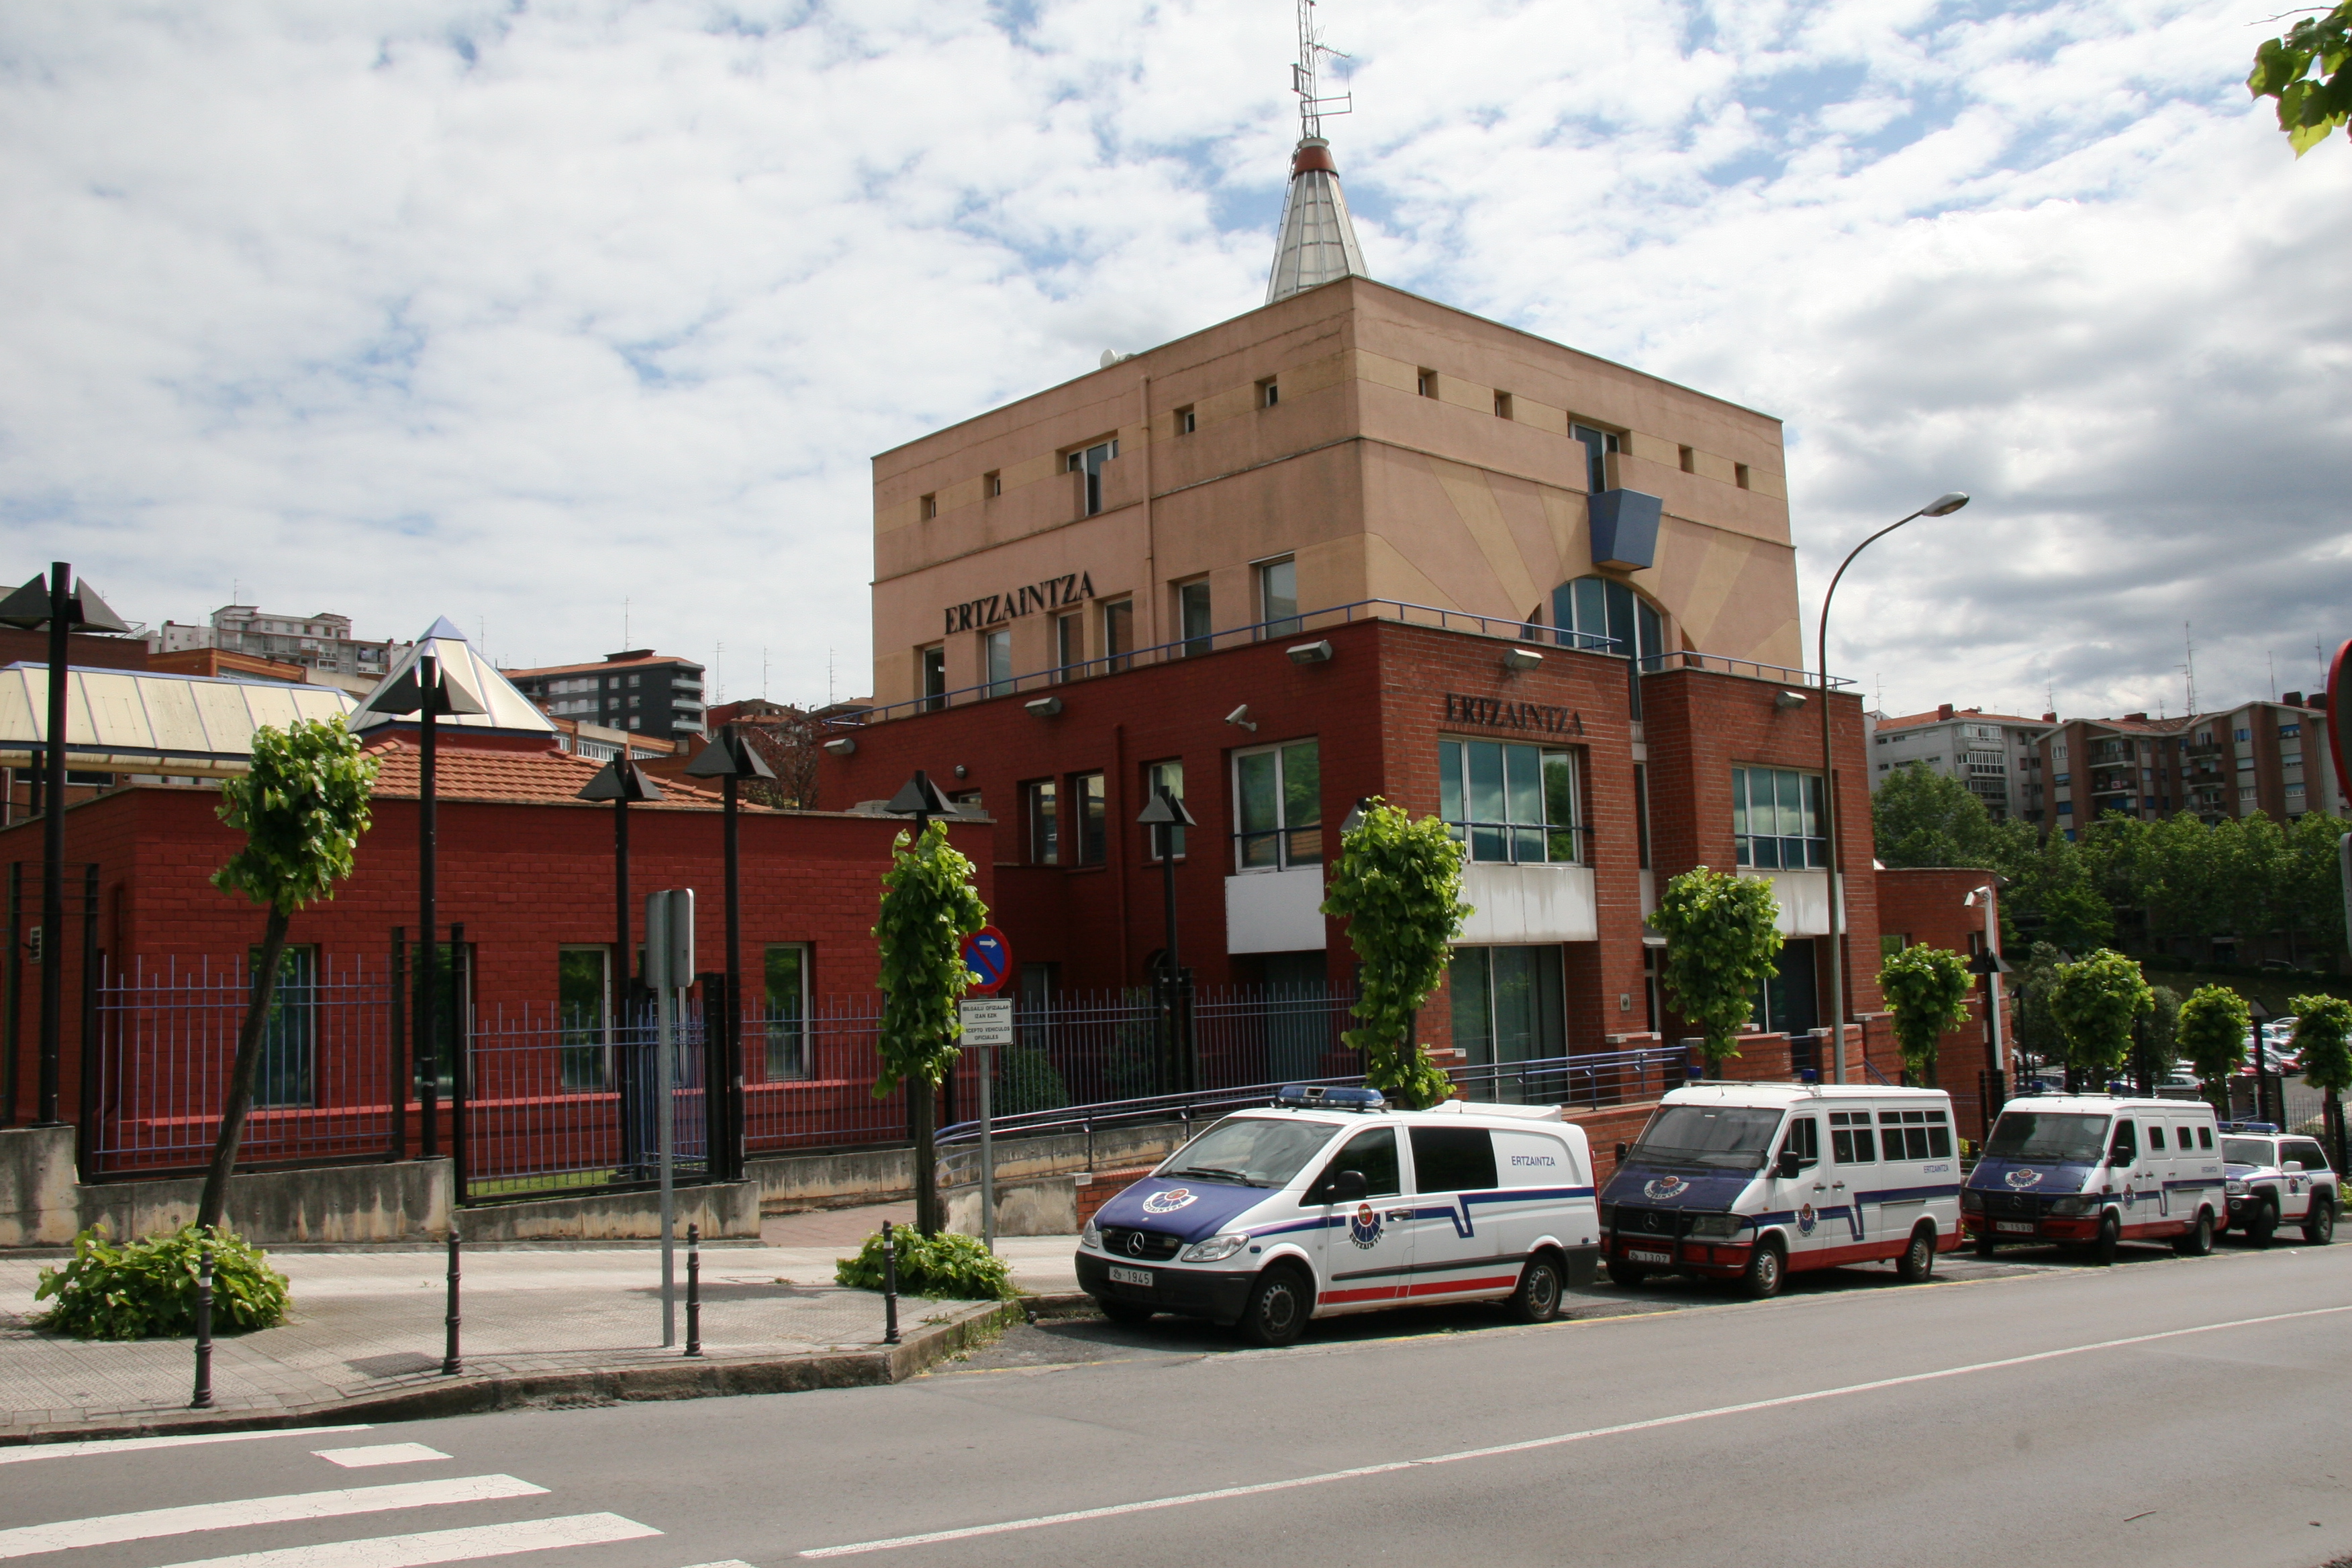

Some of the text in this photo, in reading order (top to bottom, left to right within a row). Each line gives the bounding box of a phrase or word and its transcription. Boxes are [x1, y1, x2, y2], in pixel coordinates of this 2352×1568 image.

[944, 570, 1095, 635] ERTZAINTZA
[1447, 693, 1585, 735] ERTZAINTZA
[1511, 1155, 1556, 1167] ERTZAINTZA
[1349, 1228, 1384, 1250] ERTZAINTZA
[1128, 1271, 1150, 1285] 1945
